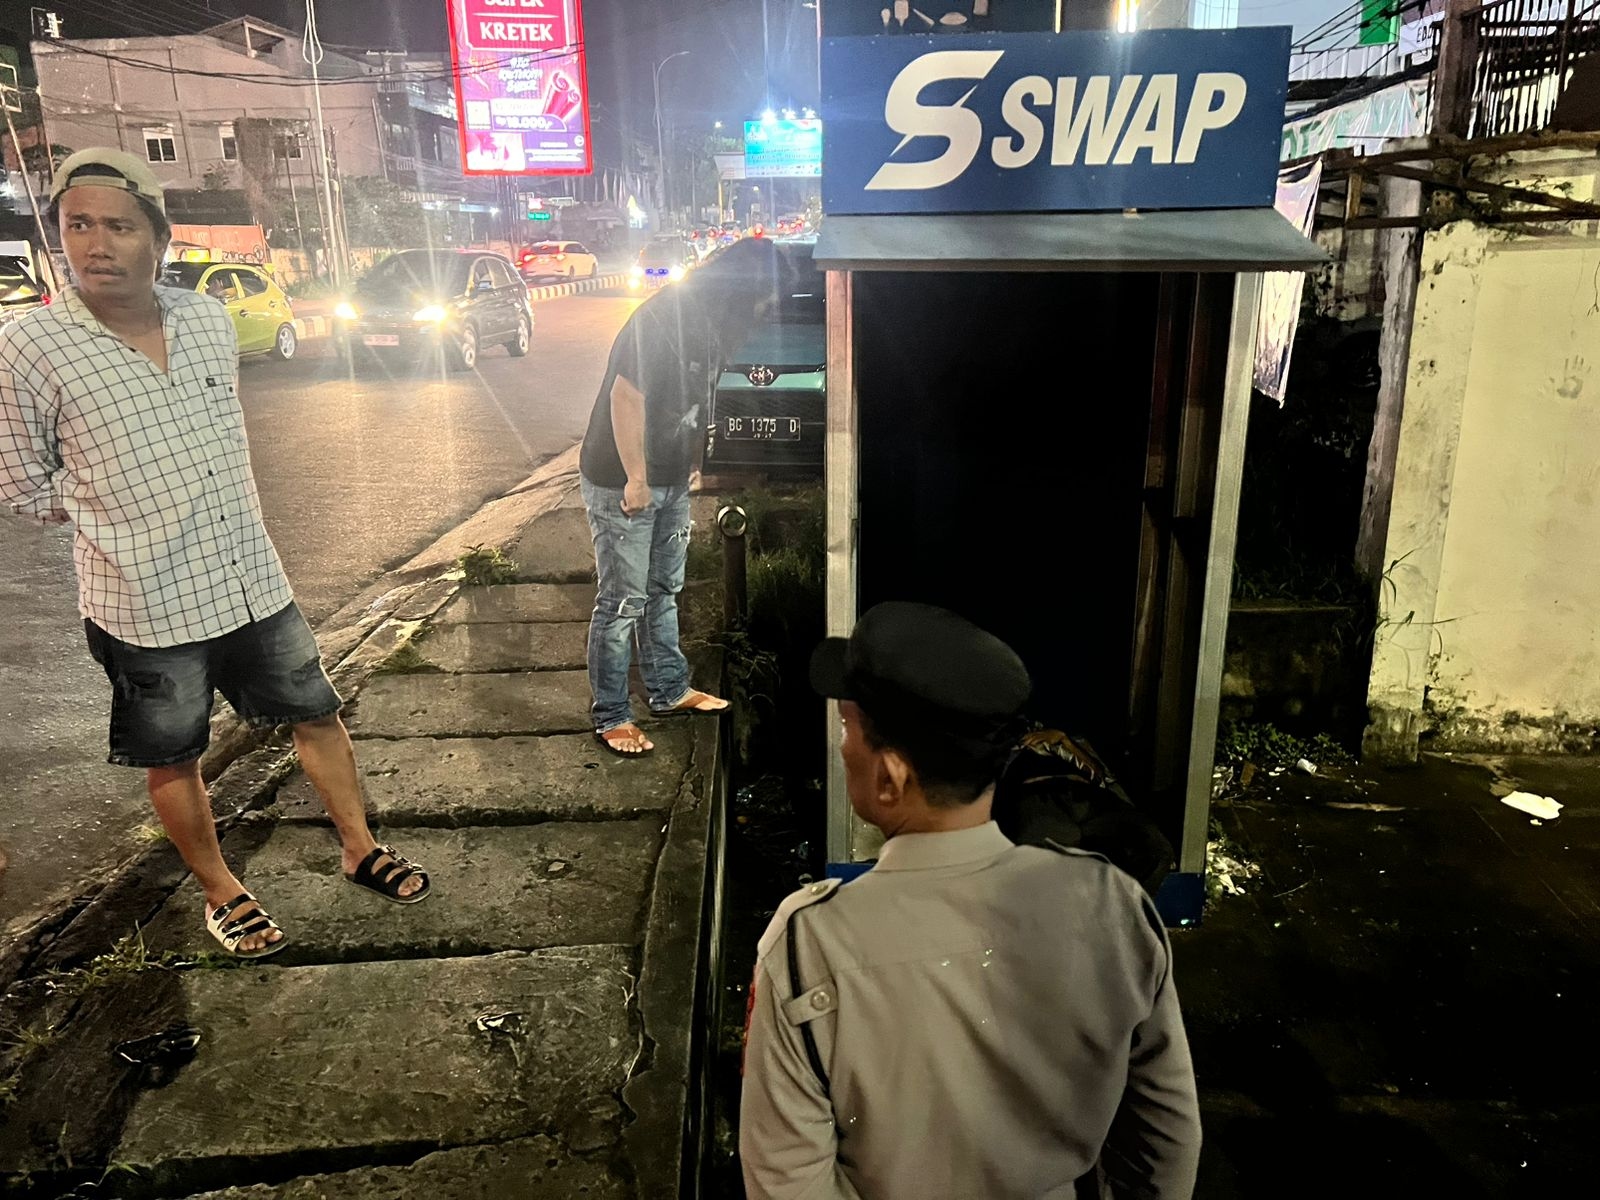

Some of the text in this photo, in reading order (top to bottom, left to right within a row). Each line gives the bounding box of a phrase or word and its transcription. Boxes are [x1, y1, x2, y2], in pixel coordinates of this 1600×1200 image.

[480, 22, 554, 42] KRETEK
[991, 72, 1247, 169] SWAP
[729, 418, 797, 433] BG 1375 D
